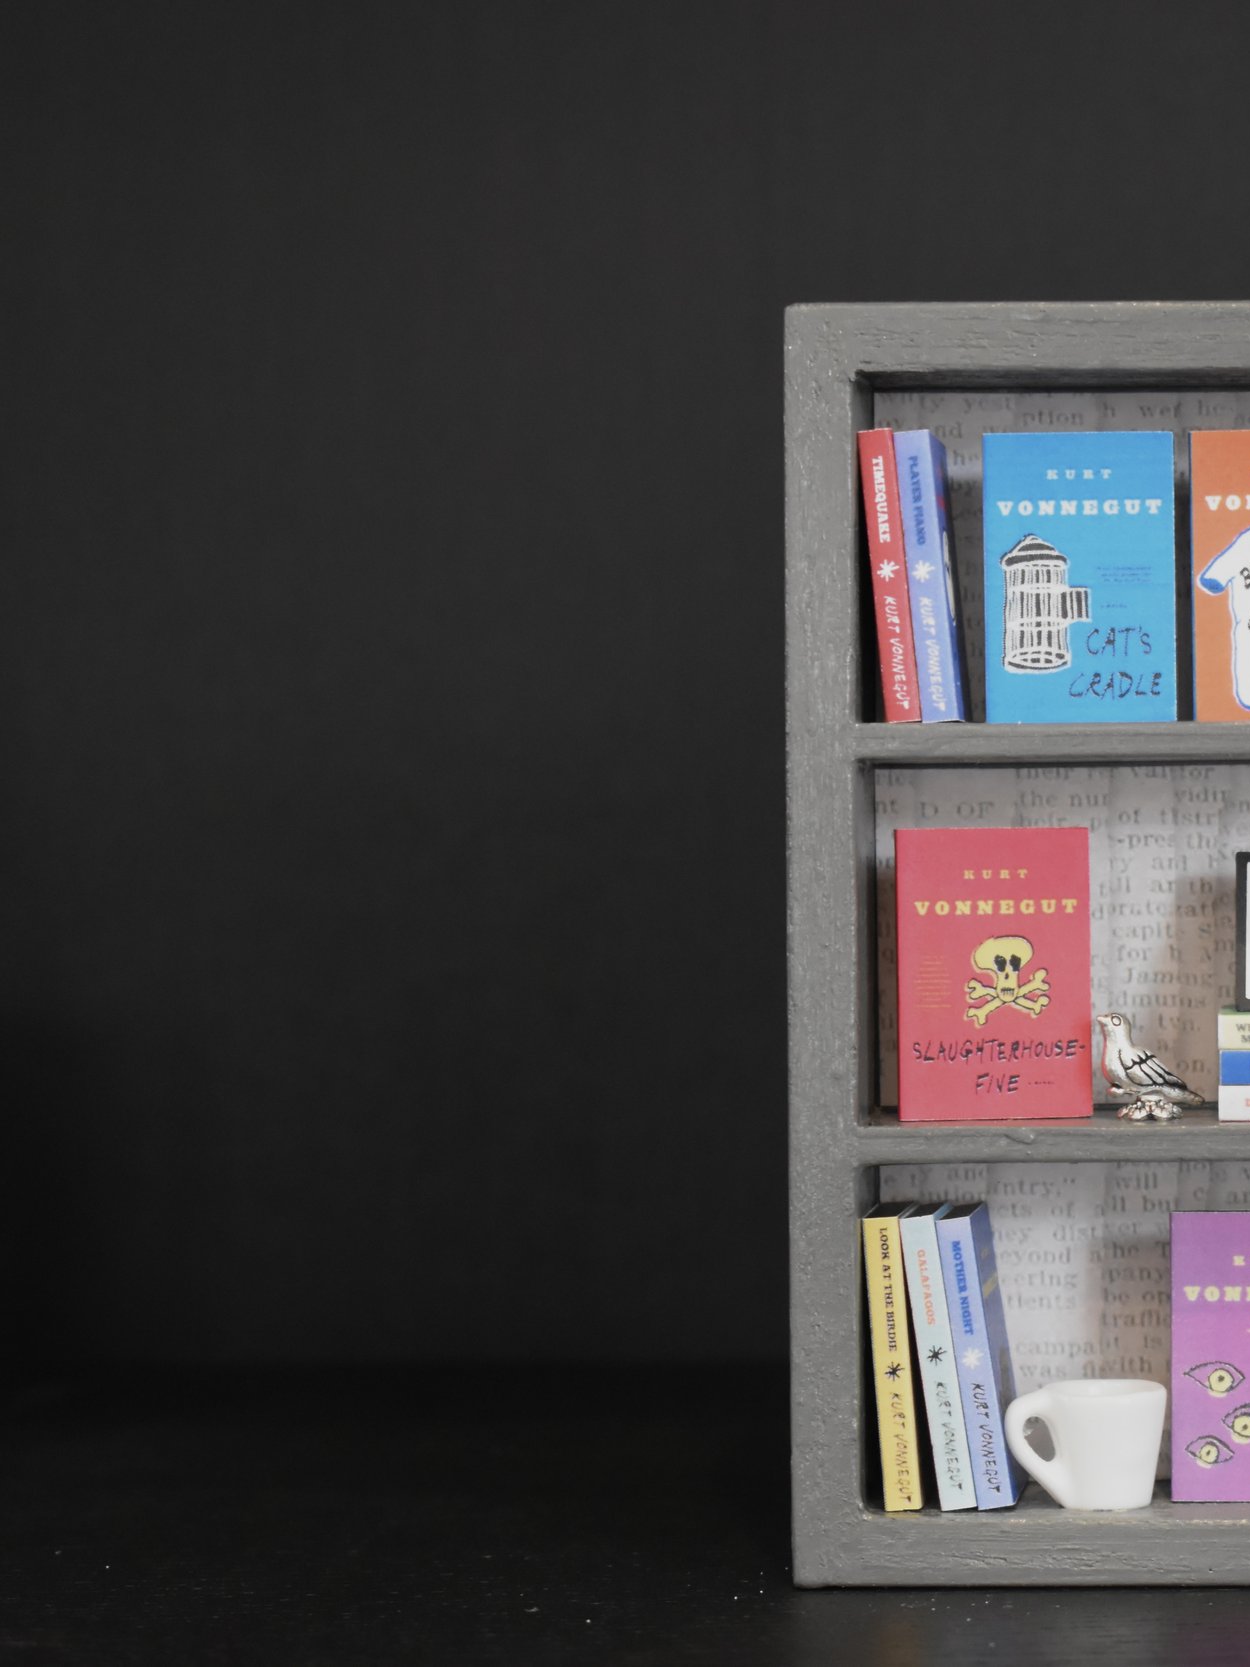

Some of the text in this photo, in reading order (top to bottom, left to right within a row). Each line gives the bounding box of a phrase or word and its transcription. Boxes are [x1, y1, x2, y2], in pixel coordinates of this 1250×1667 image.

[872, 456, 891, 543] TIMEQUAKE
[908, 455, 927, 546] PLAYER PIANO
[996, 499, 1163, 517] VONNEGUT
[1046, 468, 1112, 480] KURT
[883, 595, 910, 710] KURT VONNEGUT
[920, 596, 947, 712] KURT VONNEGUT
[1086, 625, 1153, 657] CAT'S
[1068, 671, 1163, 700] CRADLE
[914, 899, 1078, 916] VONNEGUT
[963, 868, 1029, 880] KURT
[912, 1037, 1086, 1065] SLAUGHTERHOUSE-
[974, 1072, 1021, 1095] FIVE
[880, 1227, 897, 1352] LOOK AT THE BIRDIE
[951, 1240, 974, 1335] MOTHER NIGHT
[890, 1392, 913, 1503] KURT VONNEGUT
[934, 1381, 963, 1490] KURT VONNEGUT
[971, 1382, 1001, 1493] KURT VONNEGUT
